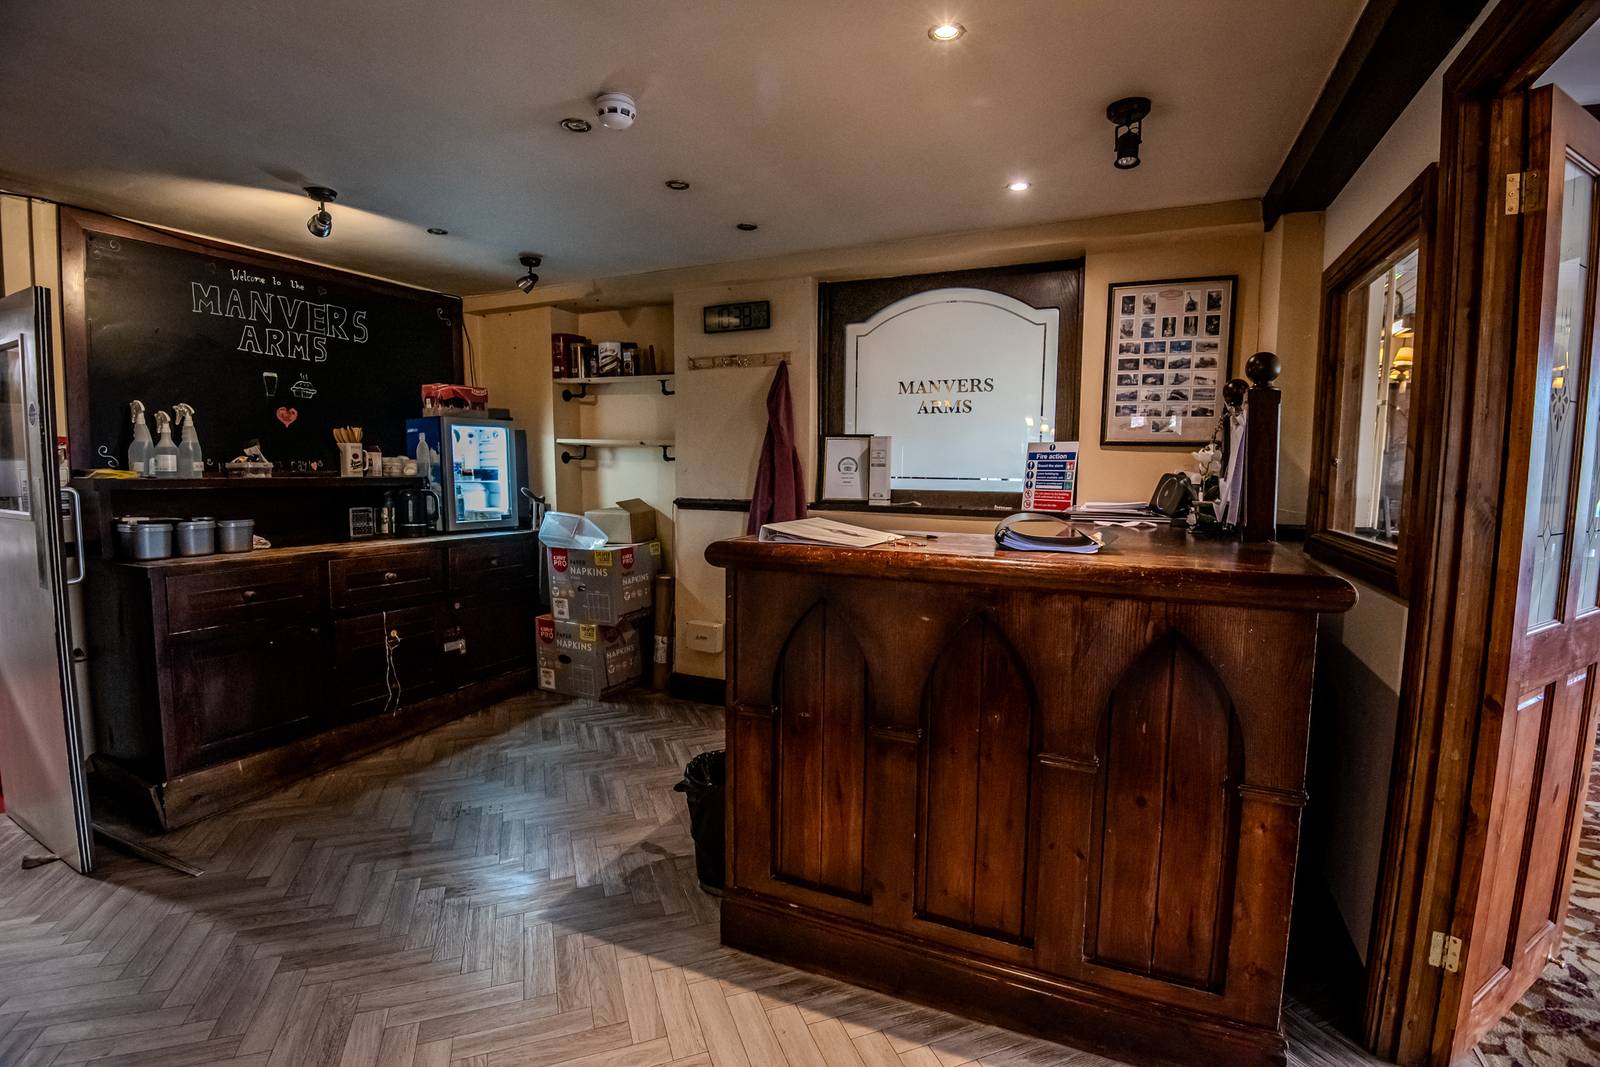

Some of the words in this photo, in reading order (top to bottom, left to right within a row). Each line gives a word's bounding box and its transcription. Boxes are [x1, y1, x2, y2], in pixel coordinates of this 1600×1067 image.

[230, 269, 265, 285] Welcome
[272, 276, 281, 286] to
[290, 280, 304, 291] the
[192, 282, 368, 343] MANVERS
[237, 325, 327, 362] ARMS
[898, 378, 994, 394] MANVERS
[917, 400, 972, 414] ARMS
[570, 566, 608, 577] NAPKINS
[622, 573, 649, 586] NAPKINS
[540, 631, 554, 639] PRO
[556, 639, 592, 652] NAPKINS
